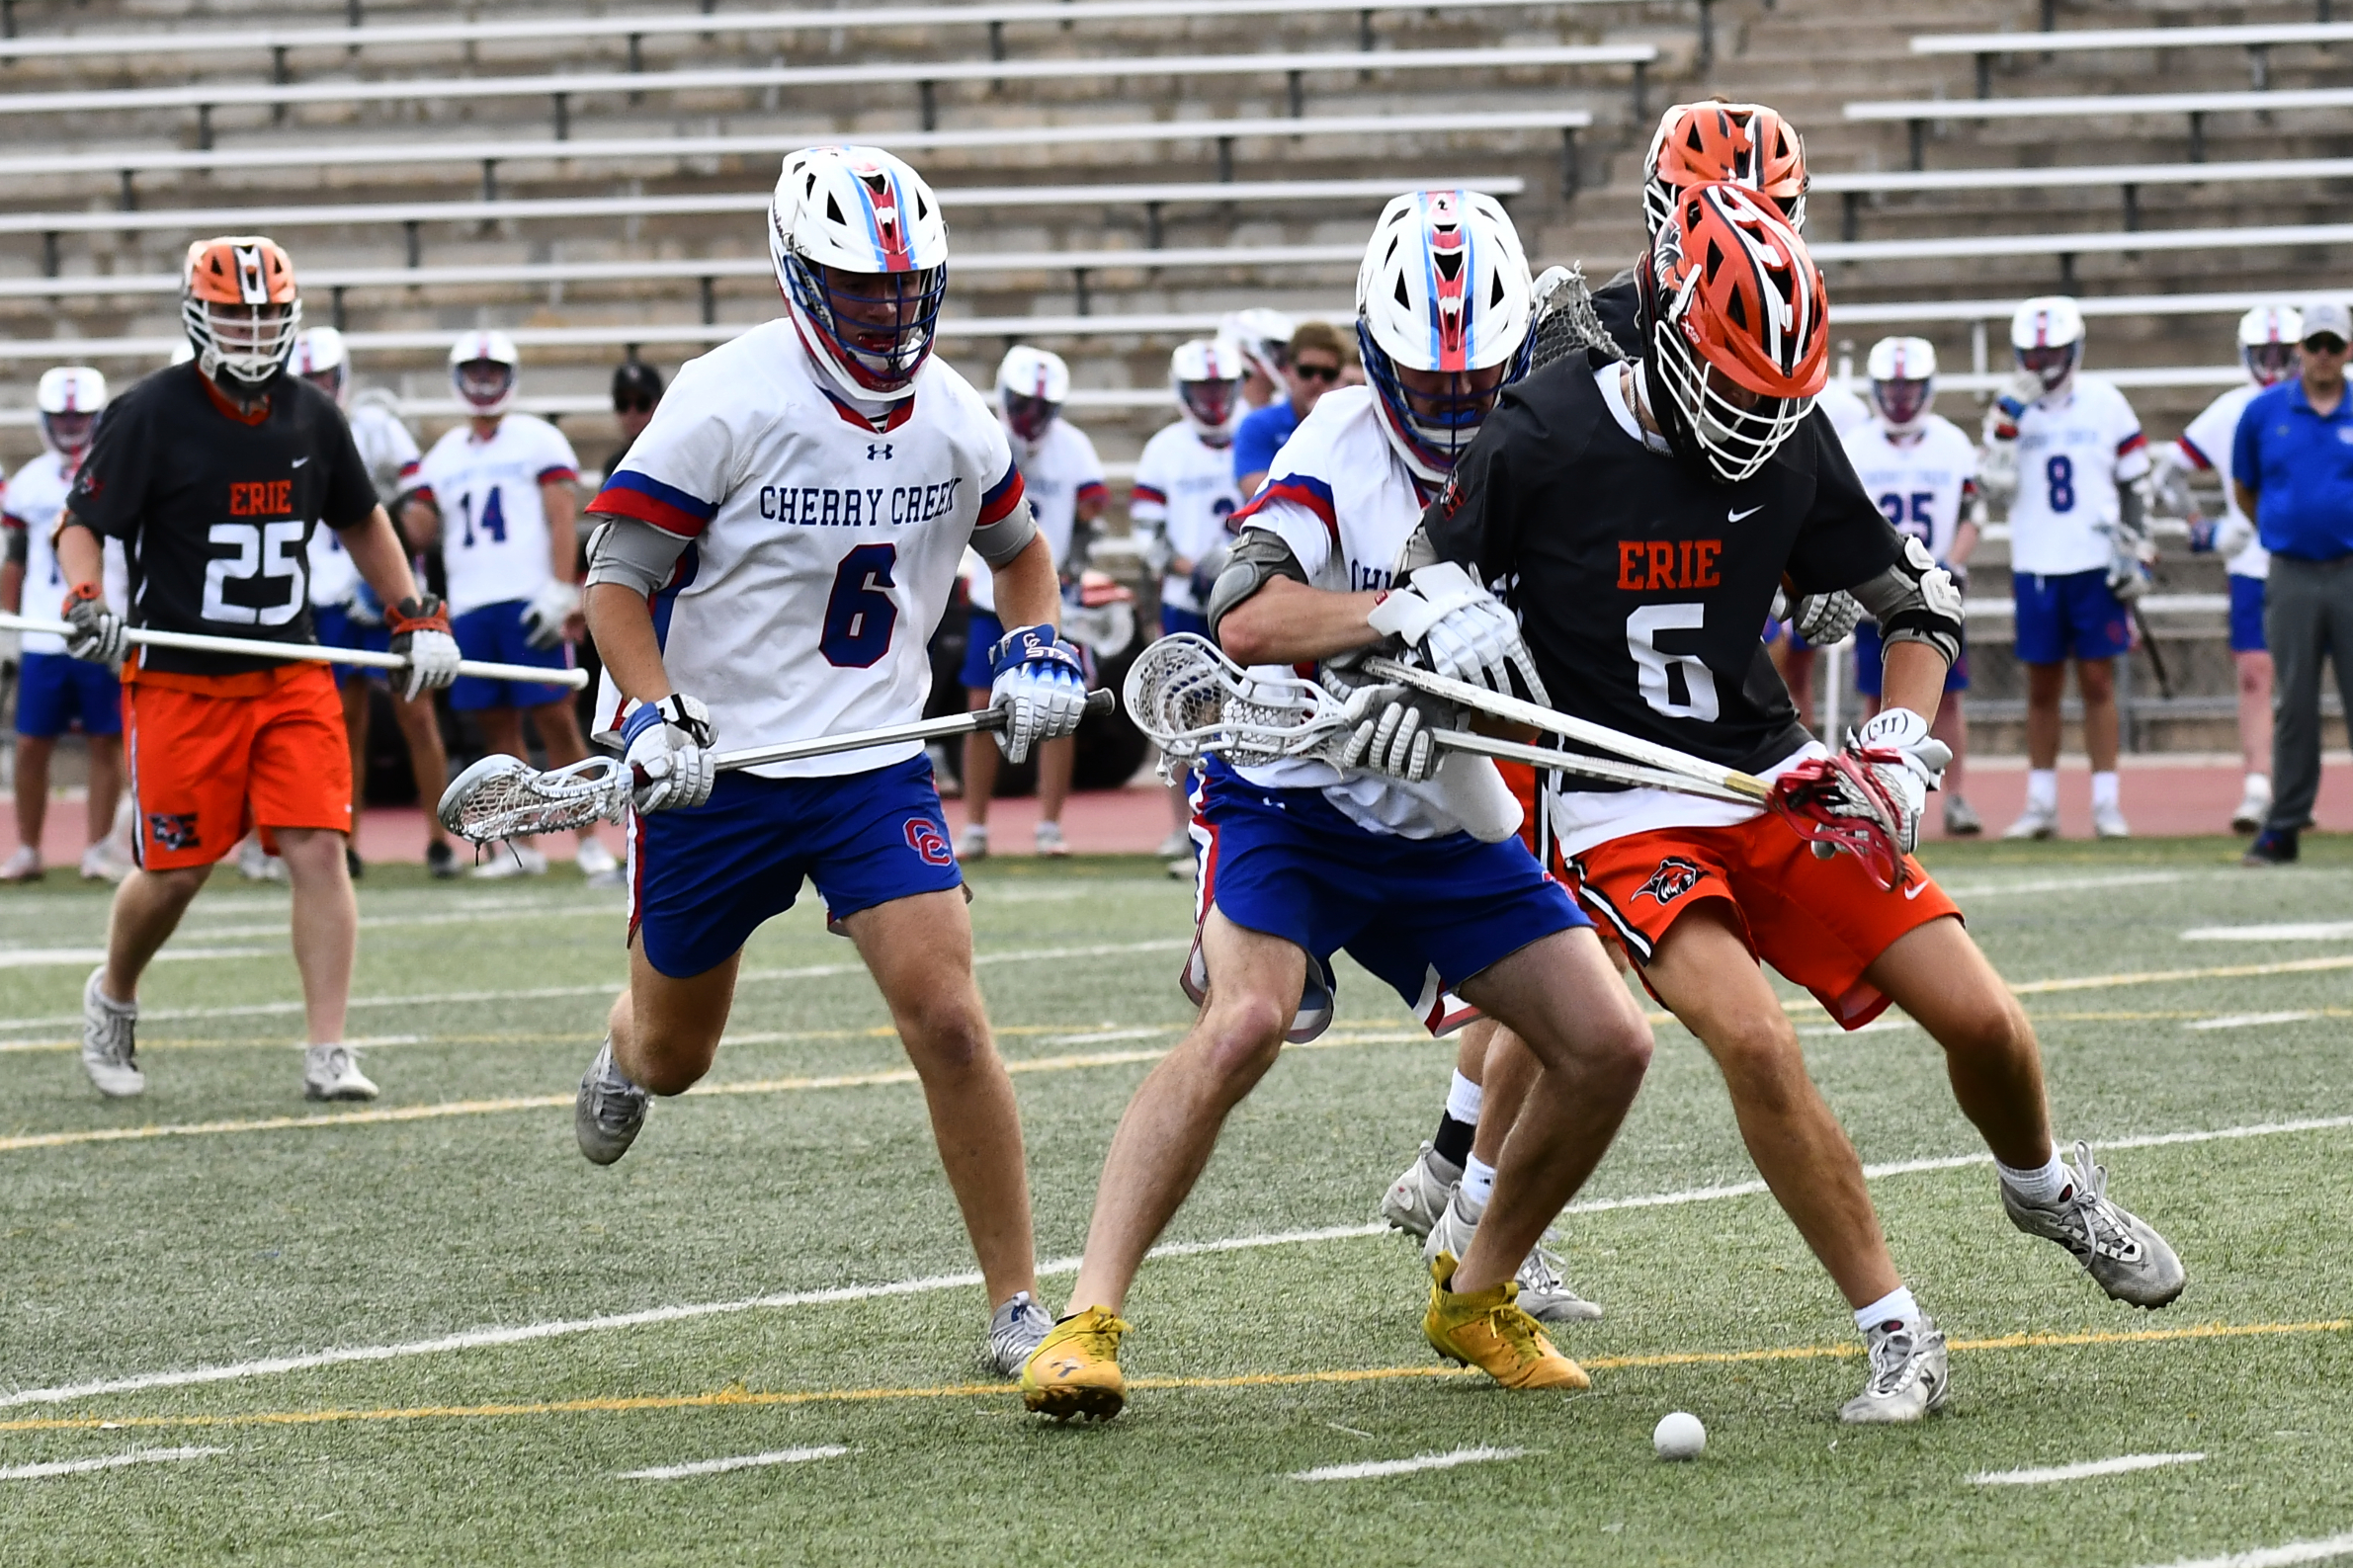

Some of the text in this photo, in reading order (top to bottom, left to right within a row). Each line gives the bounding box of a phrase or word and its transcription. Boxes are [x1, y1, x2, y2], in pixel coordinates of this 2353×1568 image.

[229, 479, 293, 516] ERIE
[759, 476, 963, 527] CHERRY CREEK
[2046, 454, 2075, 514] 8
[460, 484, 507, 548] 14
[200, 520, 304, 625] 25
[1617, 539, 1722, 590] ERIE
[818, 541, 898, 669] 6
[1626, 602, 1720, 722] 6
[902, 816, 953, 867] CC
